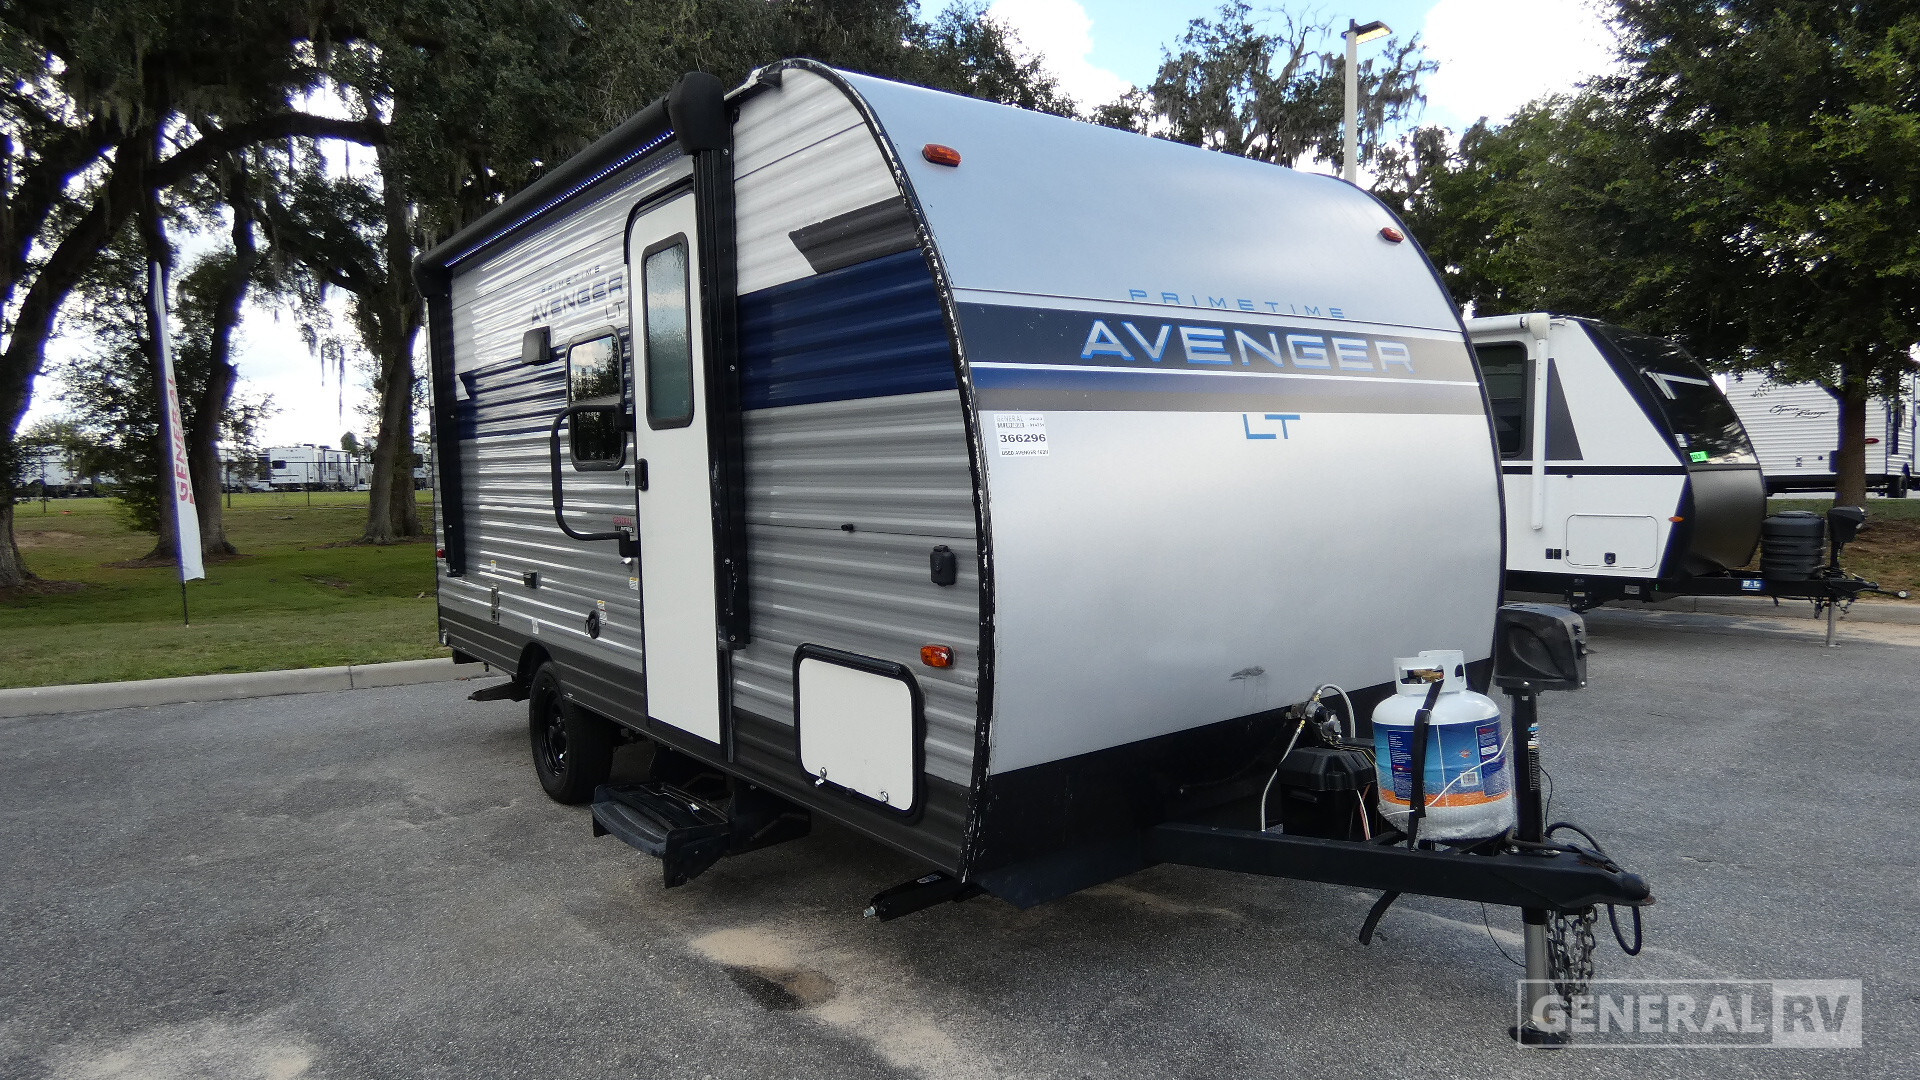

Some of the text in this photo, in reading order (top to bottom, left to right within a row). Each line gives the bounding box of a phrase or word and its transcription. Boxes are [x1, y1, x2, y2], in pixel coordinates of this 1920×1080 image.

[531, 272, 624, 324] AVENGER
[605, 300, 625, 320] LT
[1129, 289, 1345, 319] PRIMETIME
[1081, 319, 1415, 374] AVENGER
[999, 433, 1046, 443] 366296
[1243, 414, 1300, 439] LT
